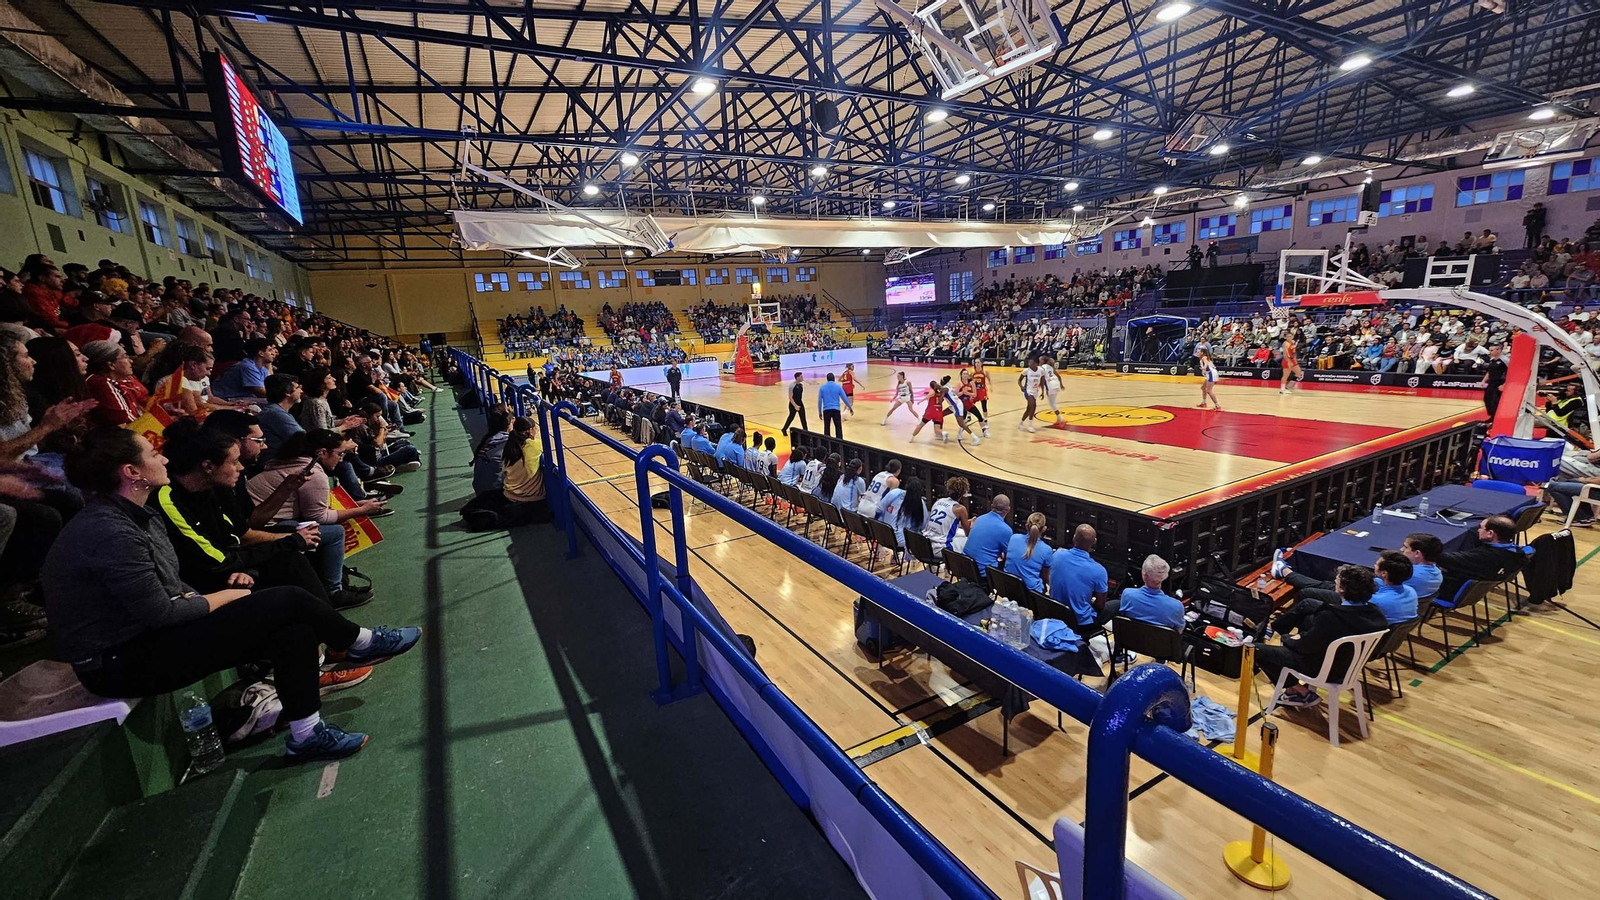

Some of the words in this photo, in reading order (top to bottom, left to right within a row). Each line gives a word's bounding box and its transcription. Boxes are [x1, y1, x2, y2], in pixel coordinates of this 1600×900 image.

[1322, 294, 1354, 305] renfe
[1488, 456, 1539, 469] molten
[804, 468, 813, 482] 11
[929, 508, 947, 526] 22
